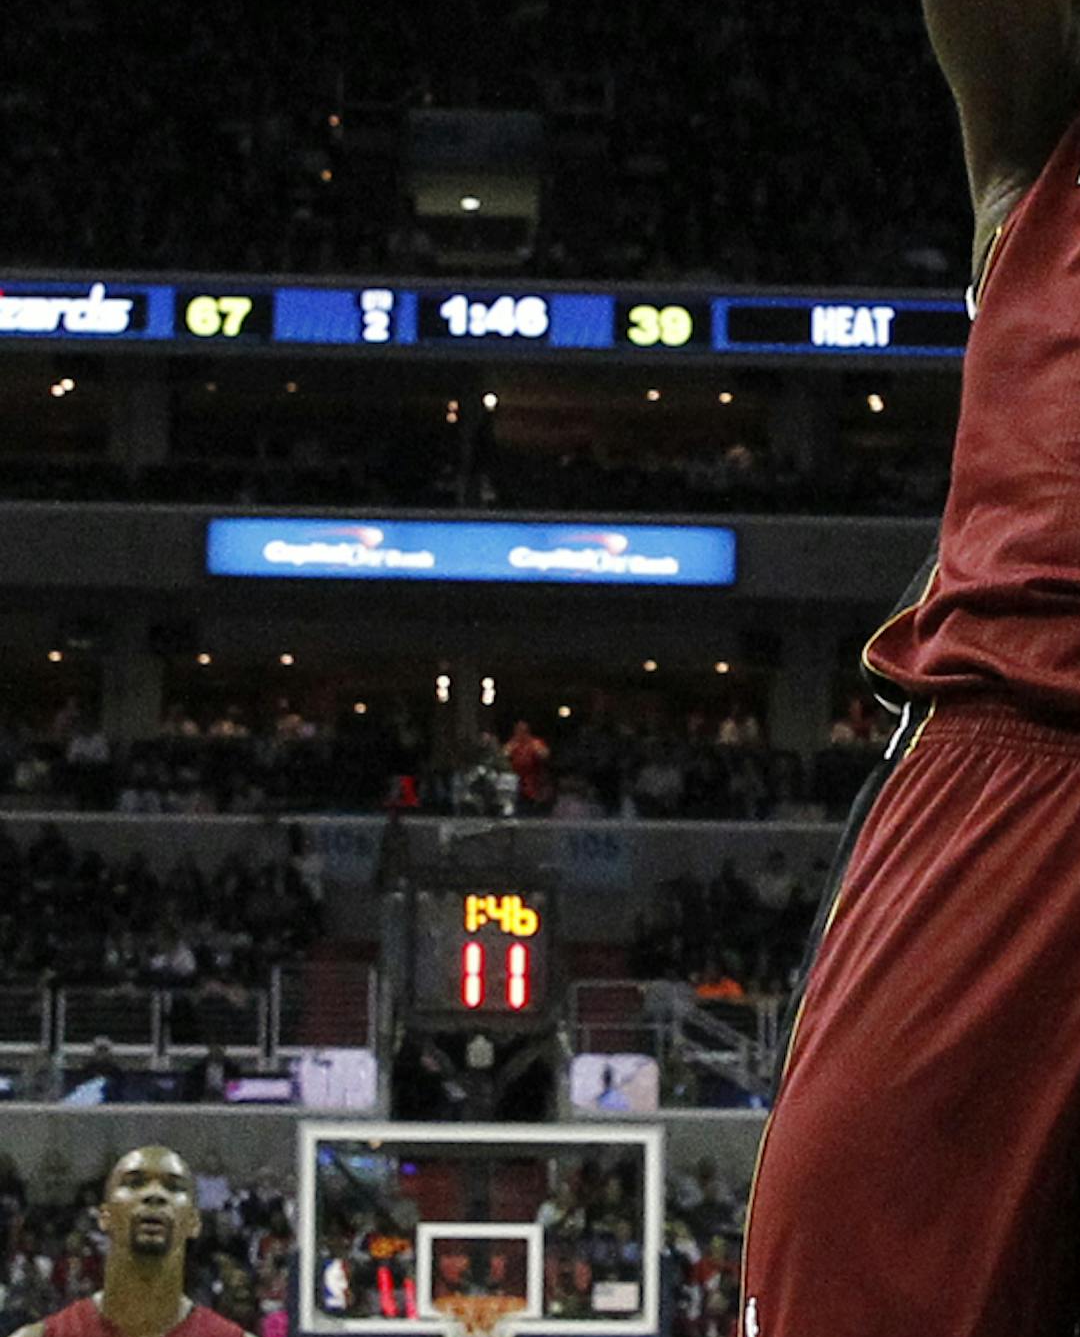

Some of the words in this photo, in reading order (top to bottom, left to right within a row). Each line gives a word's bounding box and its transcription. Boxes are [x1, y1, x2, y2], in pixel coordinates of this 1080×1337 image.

[0, 282, 133, 333] zards
[185, 295, 252, 337] 67
[439, 293, 550, 338] 1:46
[627, 304, 694, 347] 39
[810, 305, 895, 348] HEAT
[464, 893, 540, 937] 1:46
[461, 940, 530, 1010] 11
